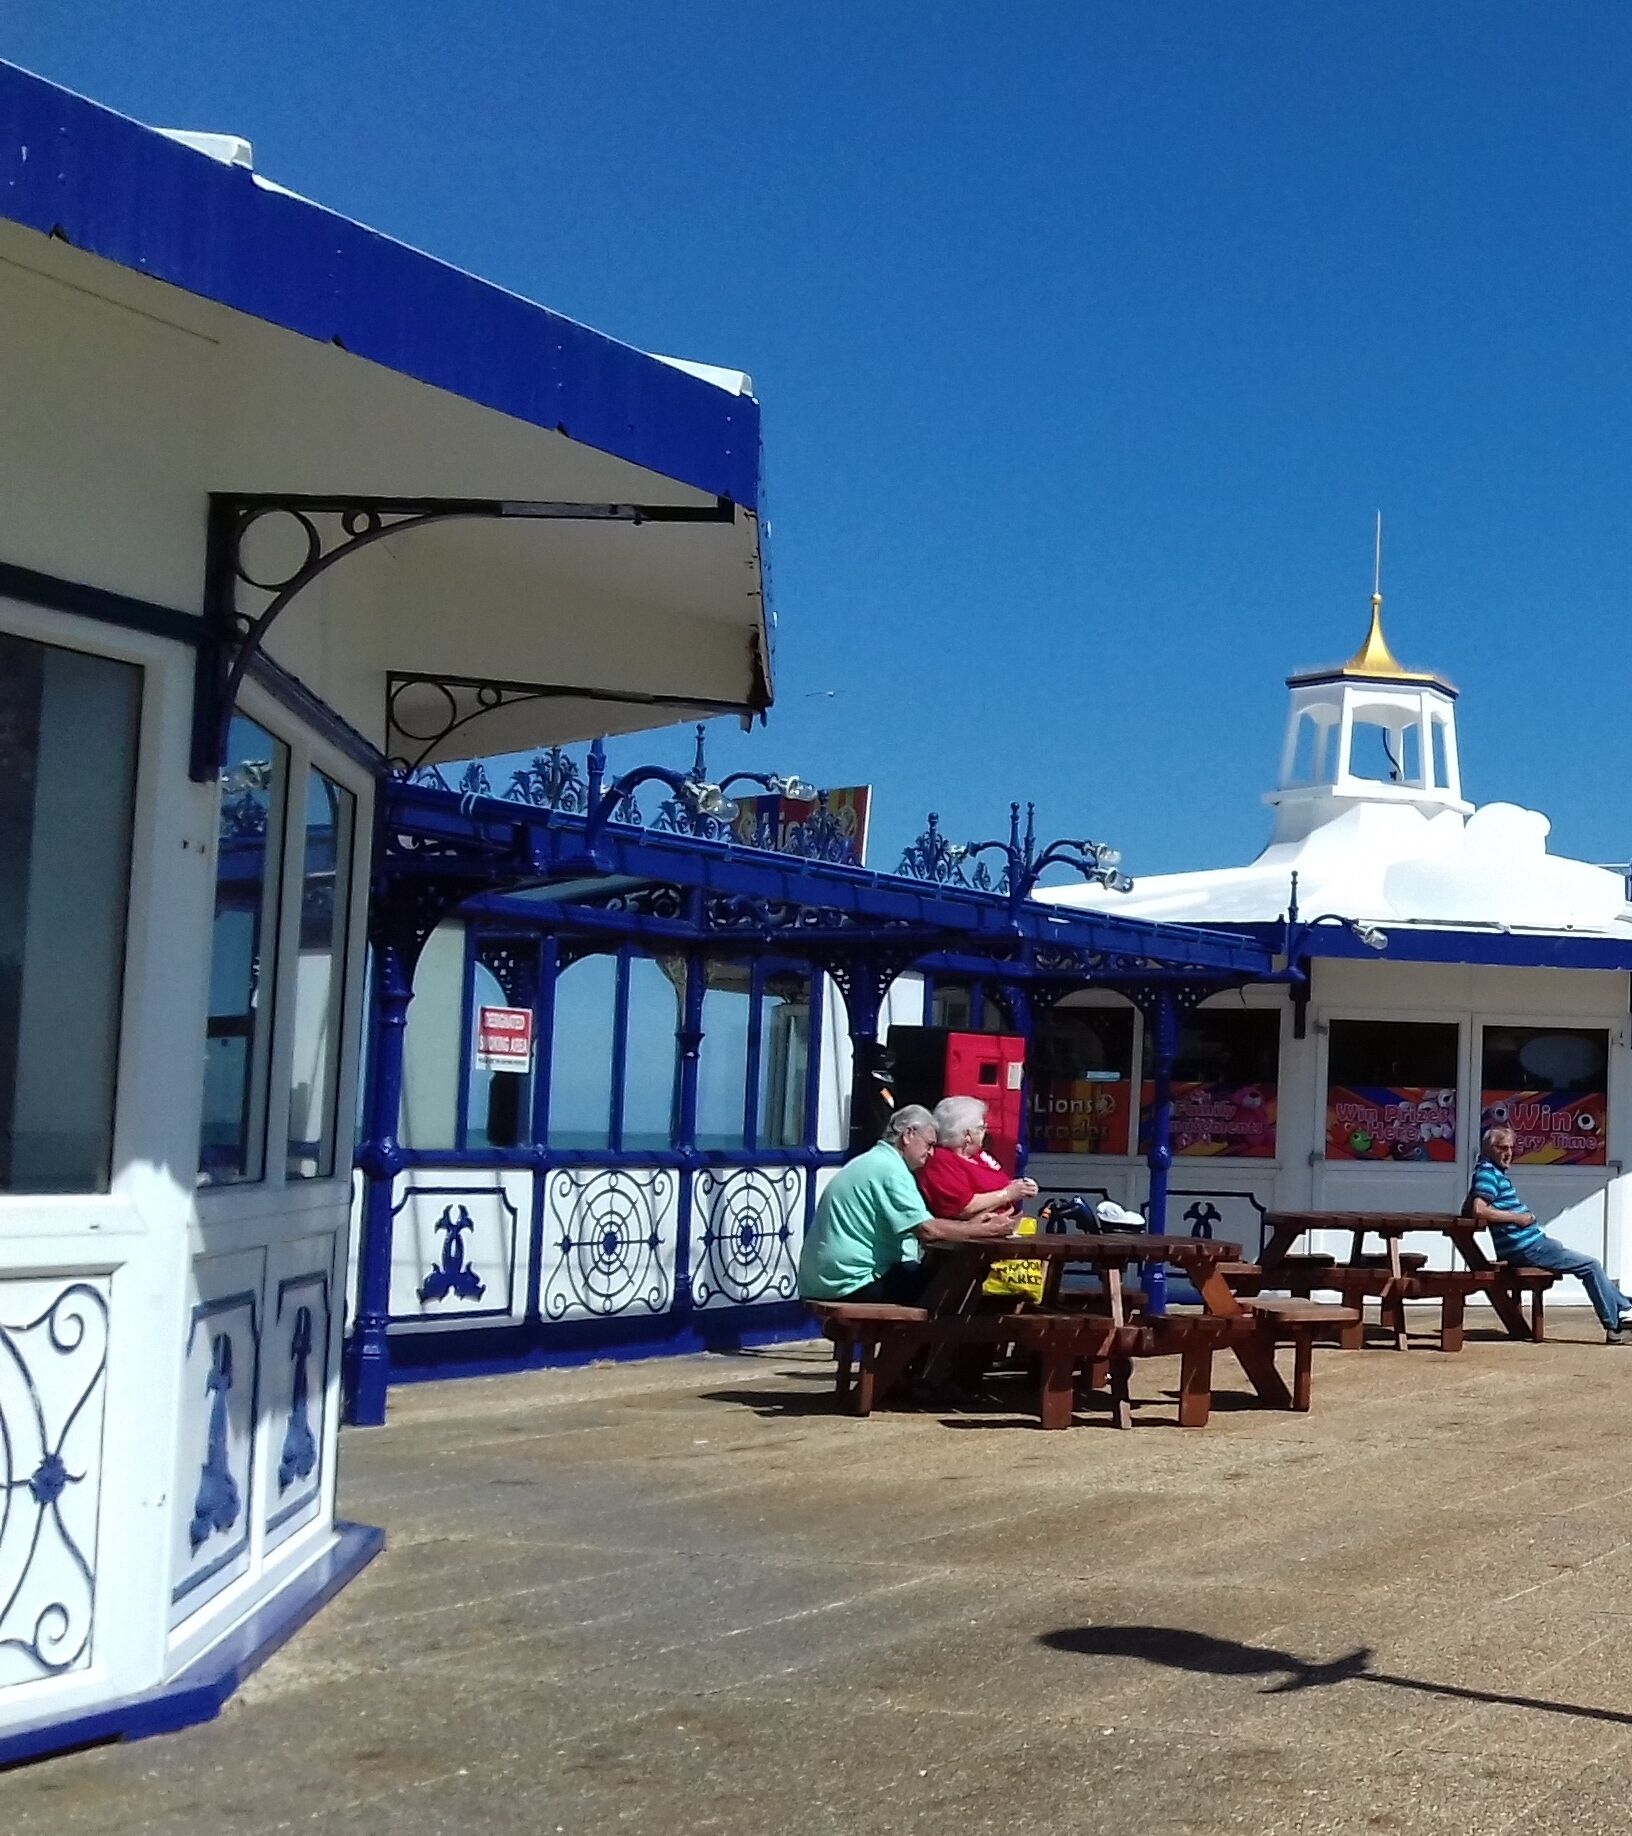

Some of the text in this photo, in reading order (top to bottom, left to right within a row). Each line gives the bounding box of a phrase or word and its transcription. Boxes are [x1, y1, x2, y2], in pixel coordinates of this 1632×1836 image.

[1033, 1093, 1094, 1114] Lions
[1336, 1103, 1450, 1123] Win Prizes
[1508, 1103, 1572, 1131] Win
[1366, 1120, 1419, 1141] Here
[1514, 1132, 1597, 1151] ery Time
